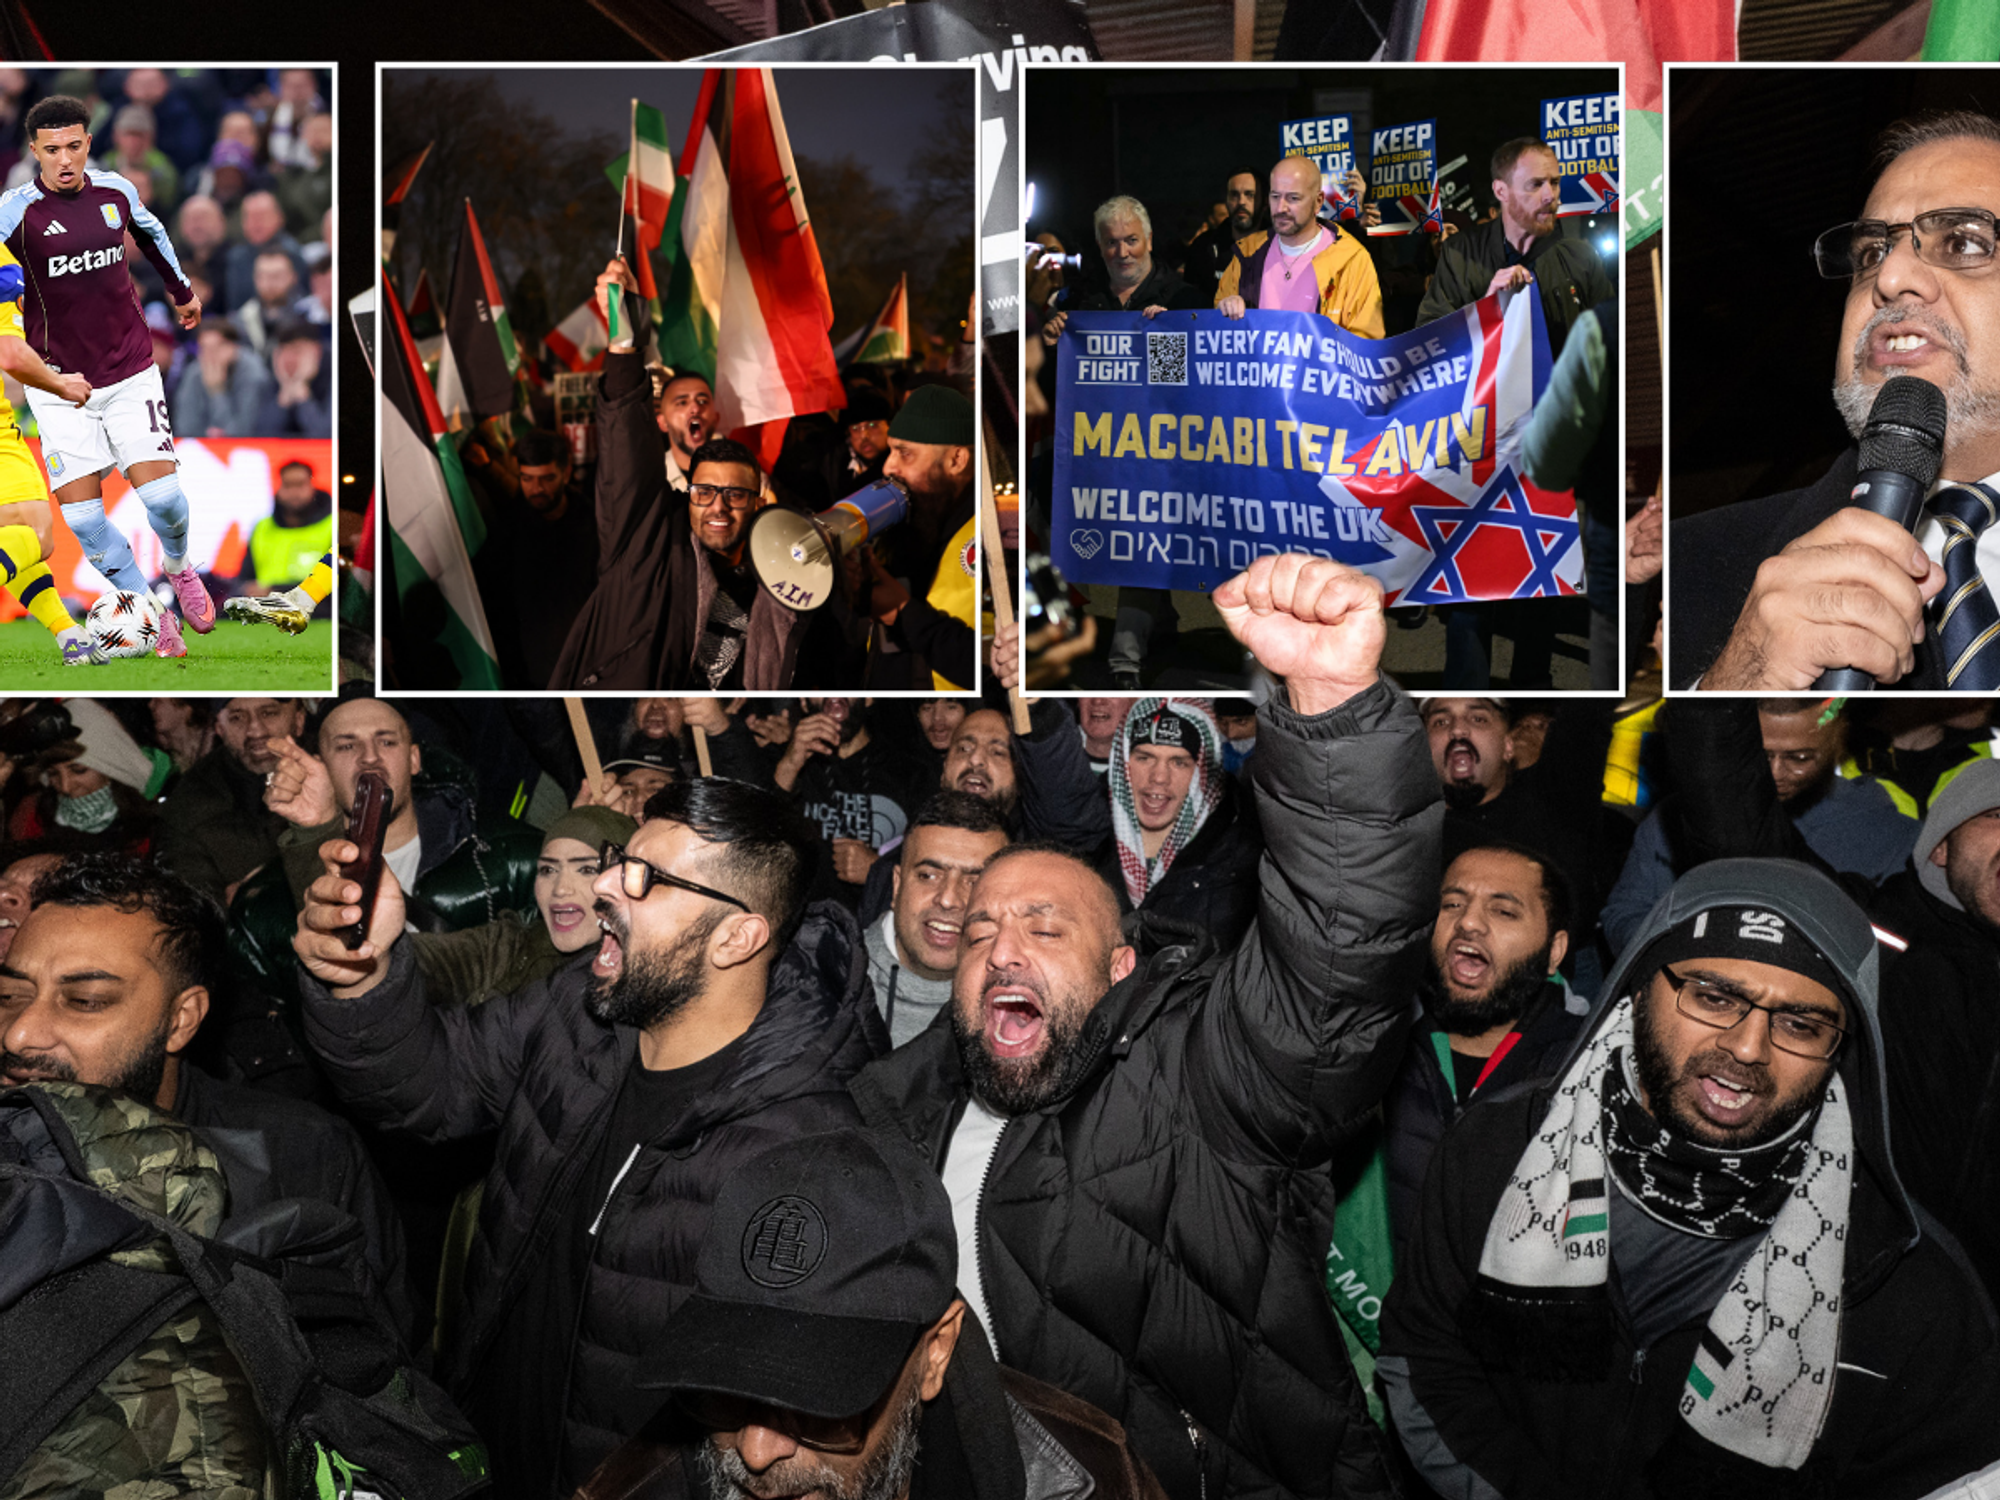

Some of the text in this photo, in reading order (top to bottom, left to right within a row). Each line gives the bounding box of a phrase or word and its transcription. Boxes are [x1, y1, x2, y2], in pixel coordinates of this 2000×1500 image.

[1546, 94, 1619, 129] KEEP
[1283, 117, 1349, 148] KEEP
[1374, 123, 1432, 156] KEEP
[1285, 141, 1350, 158] ANTI-SEMITISM
[1327, 151, 1352, 171] OF
[1372, 149, 1432, 167] ANTI-SEMITISM
[1372, 163, 1407, 186] OUT
[1408, 160, 1433, 181] OF
[1558, 157, 1620, 177] OOTBAL
[1371, 181, 1435, 200] FOOTBALL
[48, 244, 125, 277] Betano
[1086, 335, 1132, 355] OUR
[1195, 330, 1446, 380] EVERY FAN SHOULD BE
[1078, 361, 1140, 381] FIGHT
[1195, 354, 1468, 406] WELCOME EVERYWHERE
[1073, 406, 1487, 476] MACCABI TEL AVIV
[1071, 486, 1393, 543] WELCOME TO THE UK
[1110, 530, 1219, 568] הבאים
